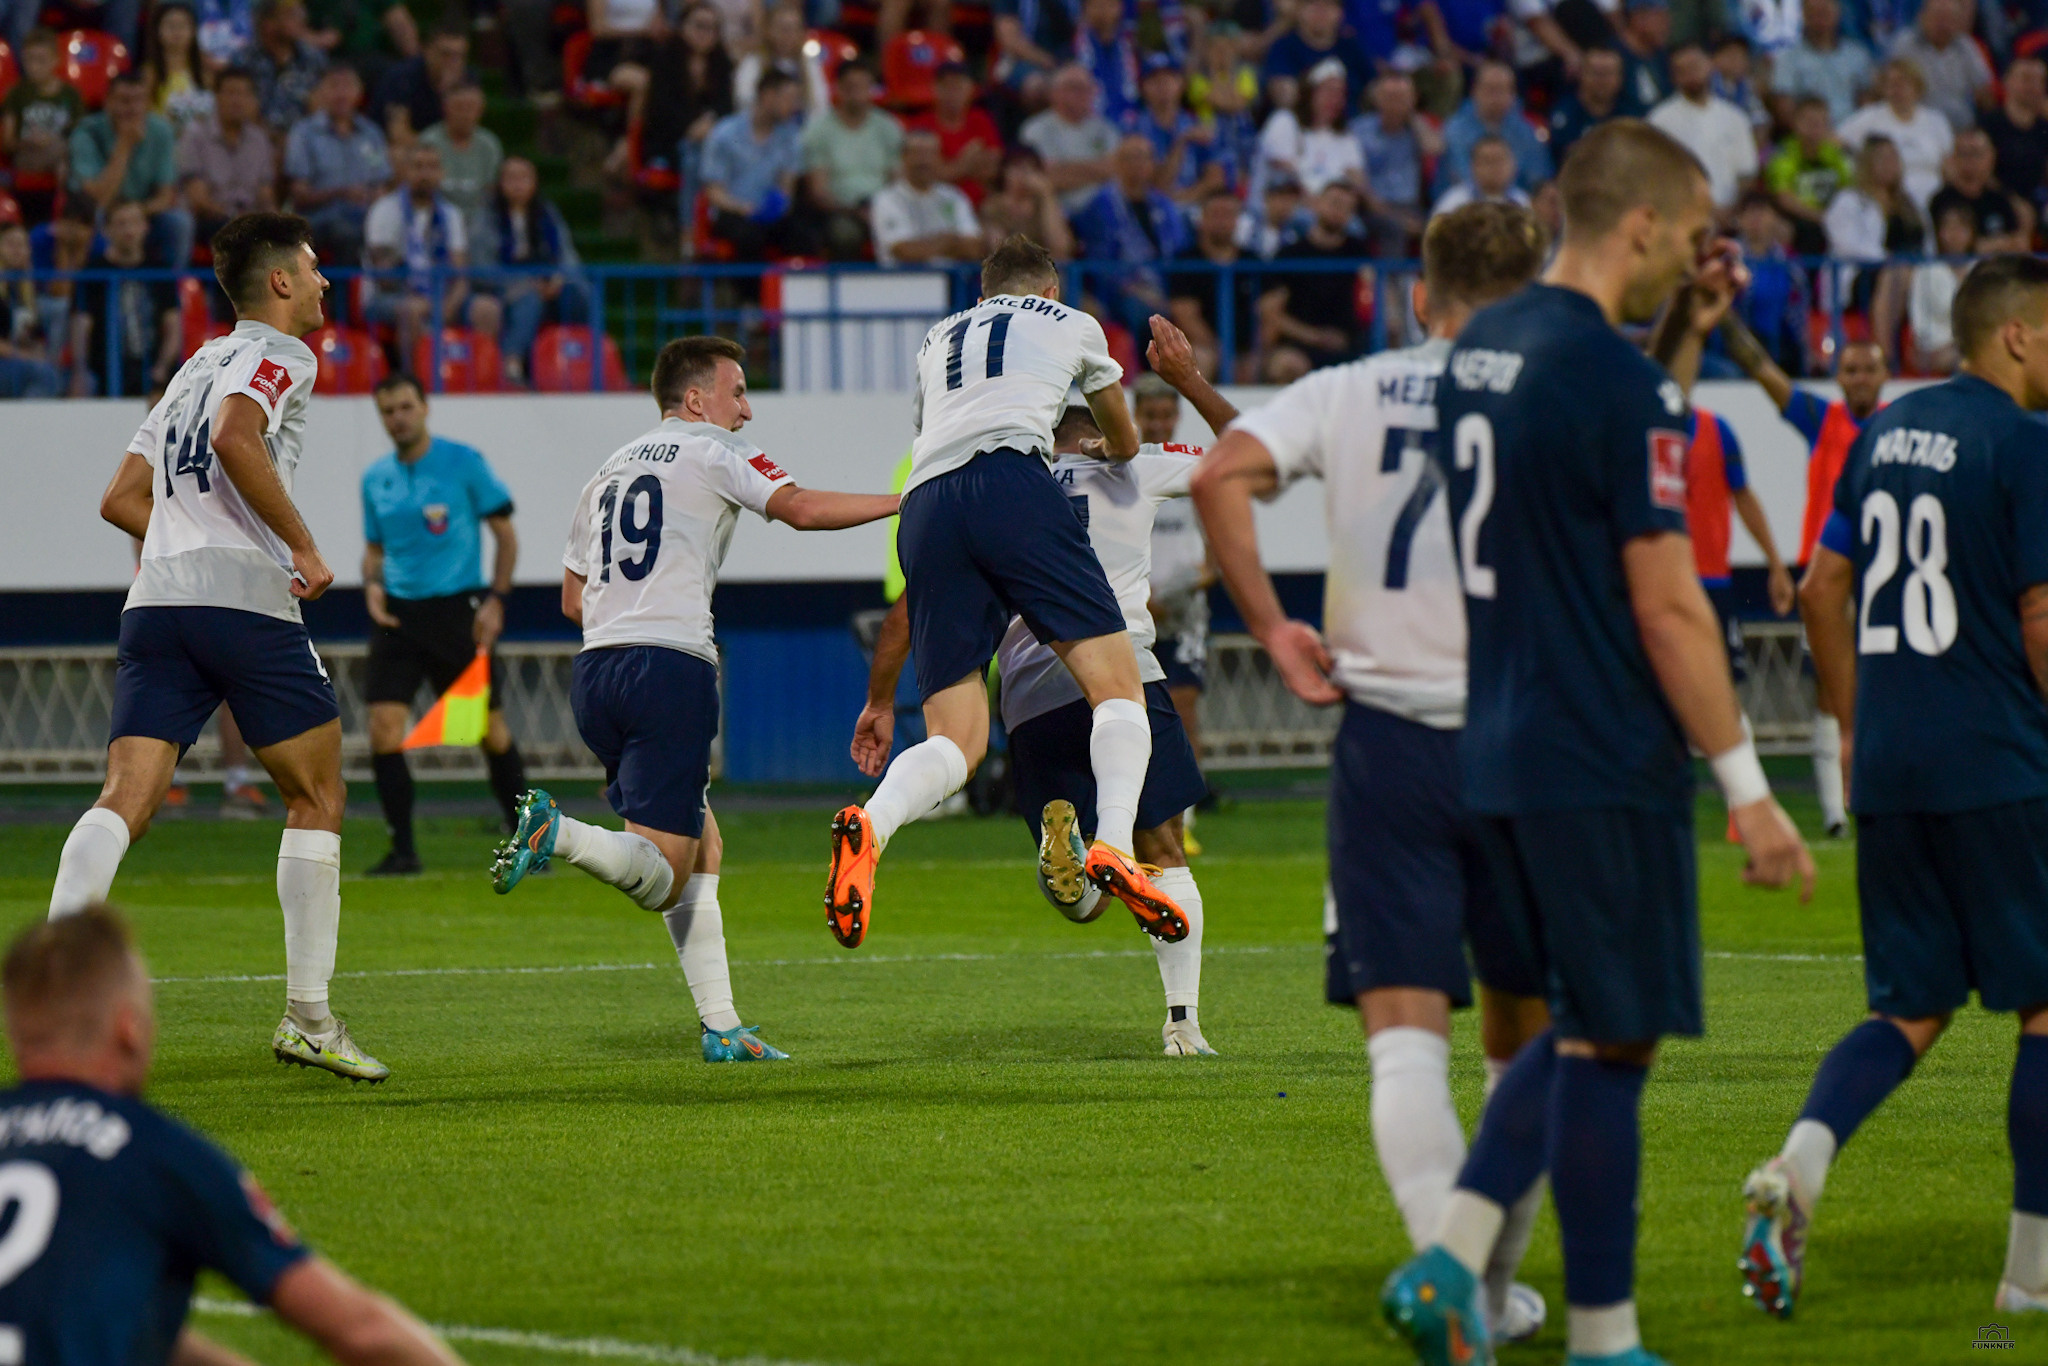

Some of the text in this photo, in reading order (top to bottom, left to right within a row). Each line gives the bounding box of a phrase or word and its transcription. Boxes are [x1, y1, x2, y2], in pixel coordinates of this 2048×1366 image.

[940, 312, 1014, 392] 11
[163, 380, 214, 498] 14
[1380, 425, 1444, 590] 7
[1454, 411, 1498, 599] 2
[599, 474, 663, 583] 19
[1859, 487, 1959, 656] 28
